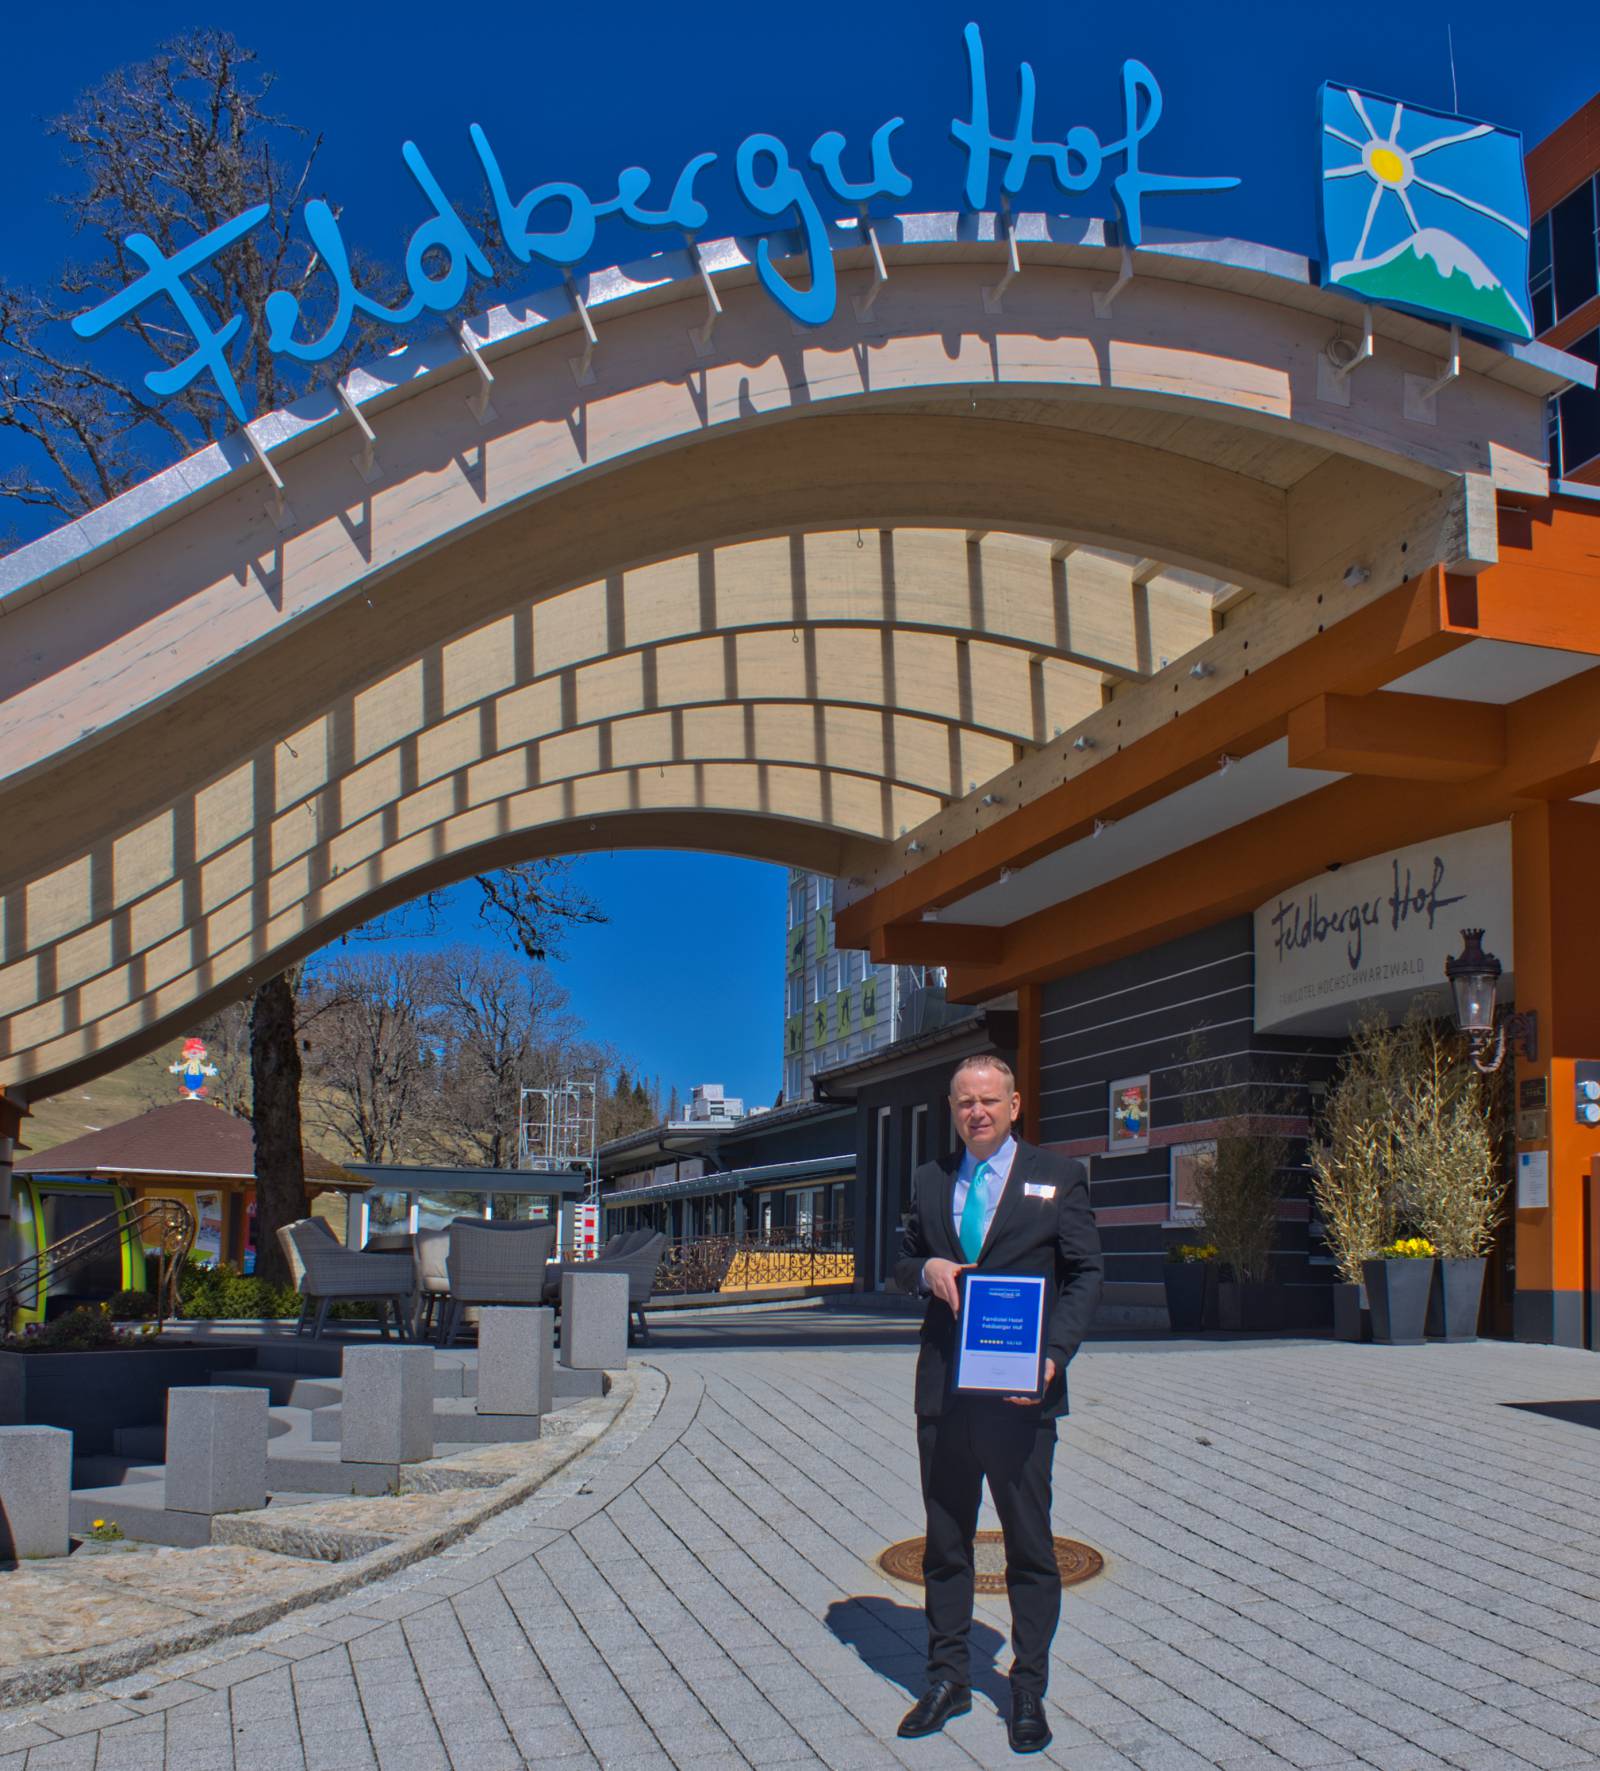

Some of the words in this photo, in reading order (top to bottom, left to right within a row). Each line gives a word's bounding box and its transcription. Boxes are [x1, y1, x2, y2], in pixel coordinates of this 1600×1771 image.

[71, 117, 914, 423] Feldberger
[950, 21, 1242, 246] Hof
[1271, 892, 1382, 970] Feldberger
[1388, 855, 1468, 931] Hof
